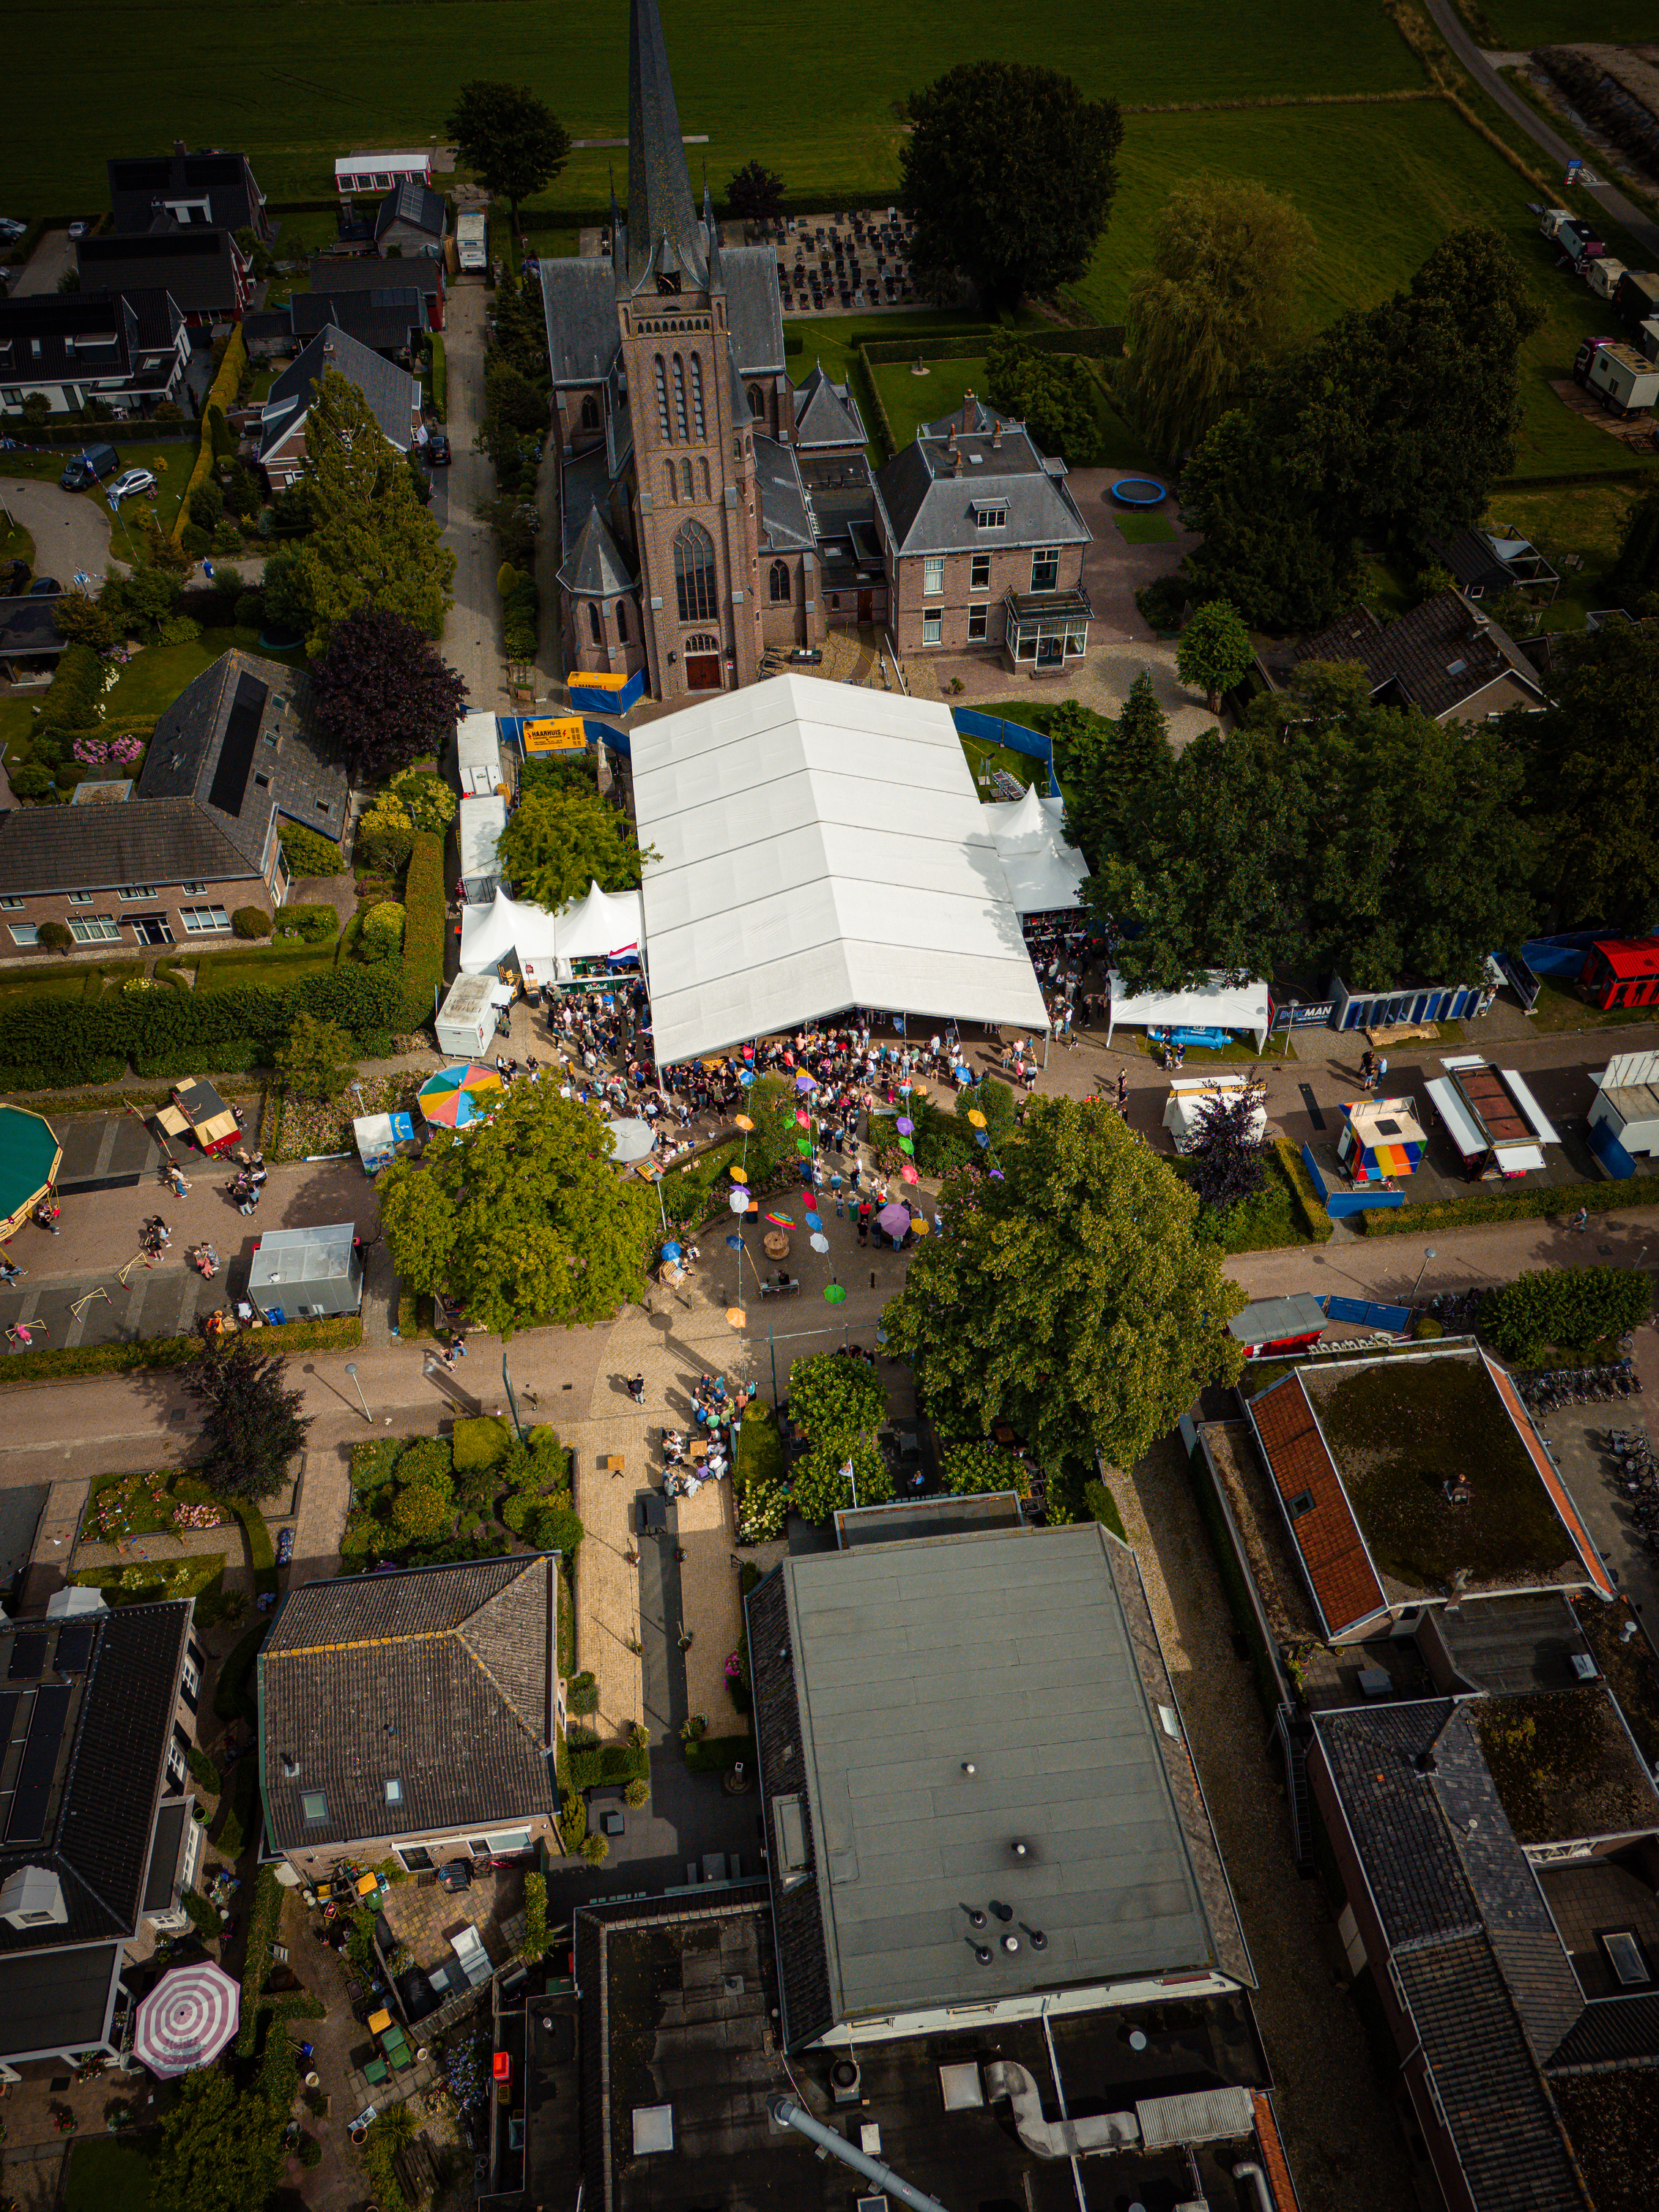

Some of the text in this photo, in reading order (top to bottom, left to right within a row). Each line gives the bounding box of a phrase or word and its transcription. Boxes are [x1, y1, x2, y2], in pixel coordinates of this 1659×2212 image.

[1578, 168, 1597, 182] 60
[532, 730, 561, 738] HAARHUIS
[584, 983, 608, 992] Grolsch
[1279, 1006, 1332, 1020] DOKMAN
